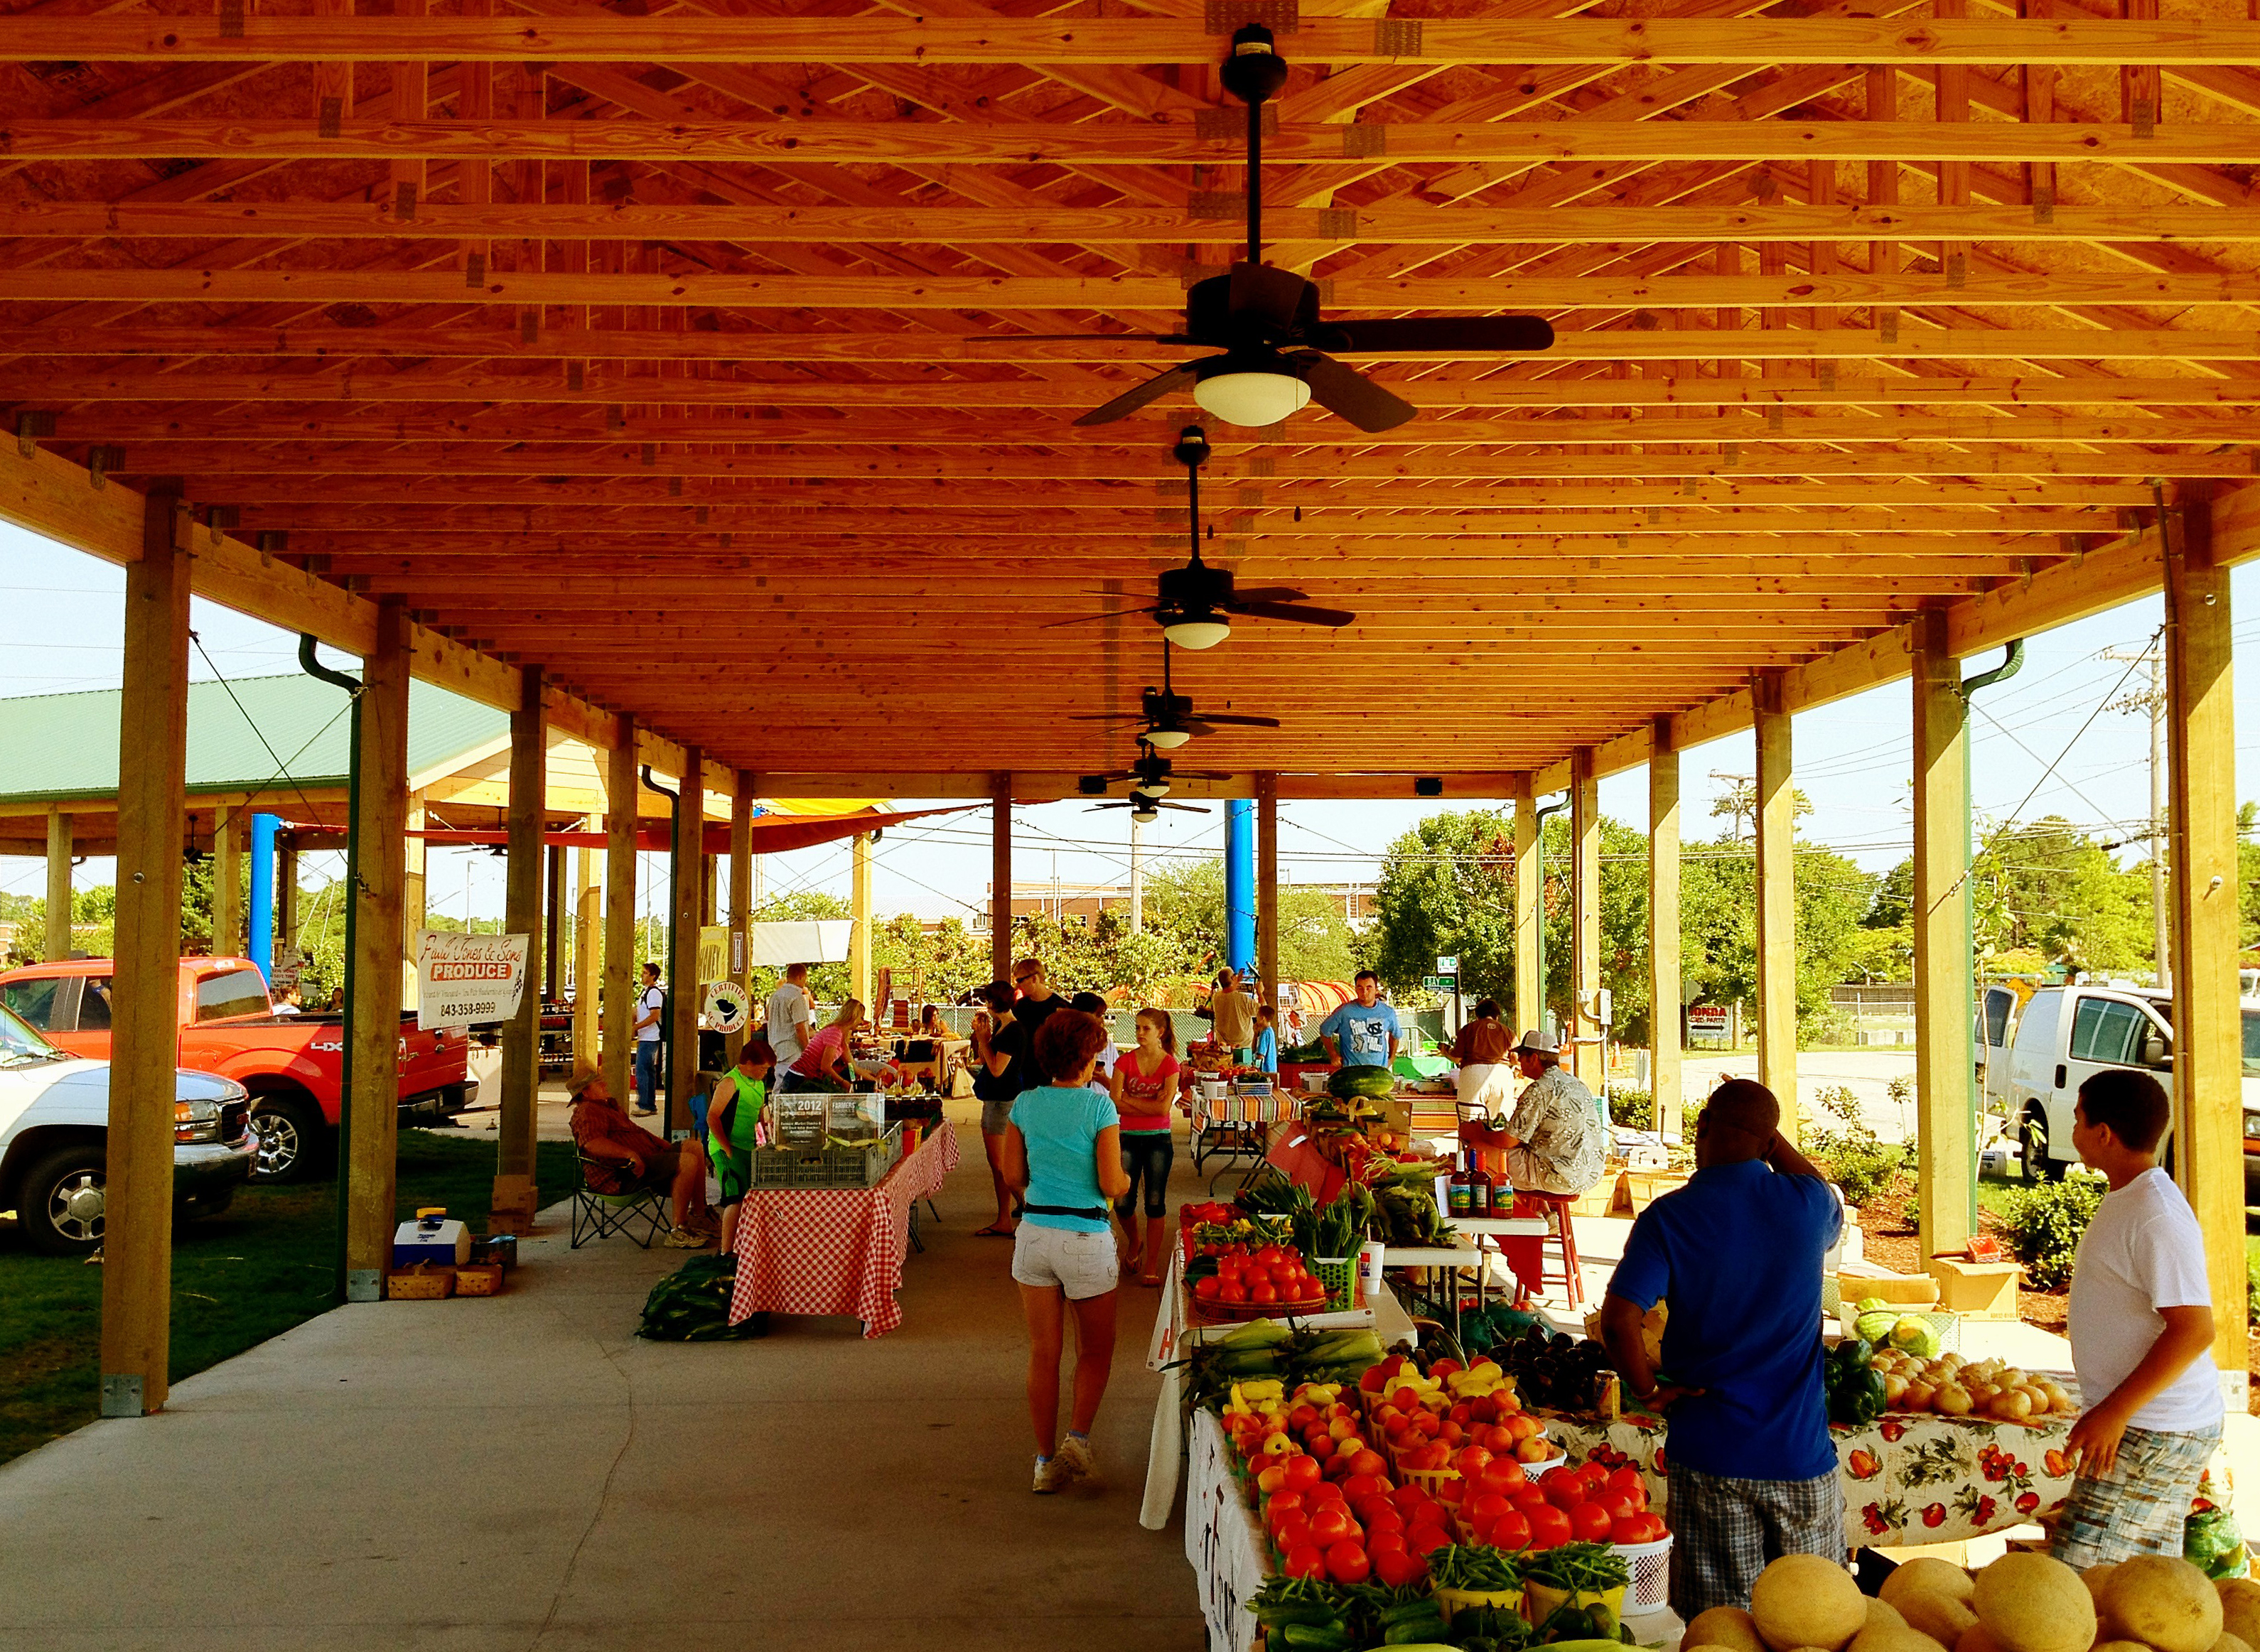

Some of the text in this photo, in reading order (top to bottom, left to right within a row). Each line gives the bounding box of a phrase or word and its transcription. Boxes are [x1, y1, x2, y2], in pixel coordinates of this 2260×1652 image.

[420, 934, 522, 962] Paul Jones & Sons
[433, 963, 507, 979] PRODUCE
[1428, 977, 1441, 986] BAY
[710, 983, 746, 1001] CERTIFIED
[441, 1001, 495, 1017] 843-358-9999
[715, 1015, 745, 1032] PRODUCT
[797, 1101, 822, 1111] 2012
